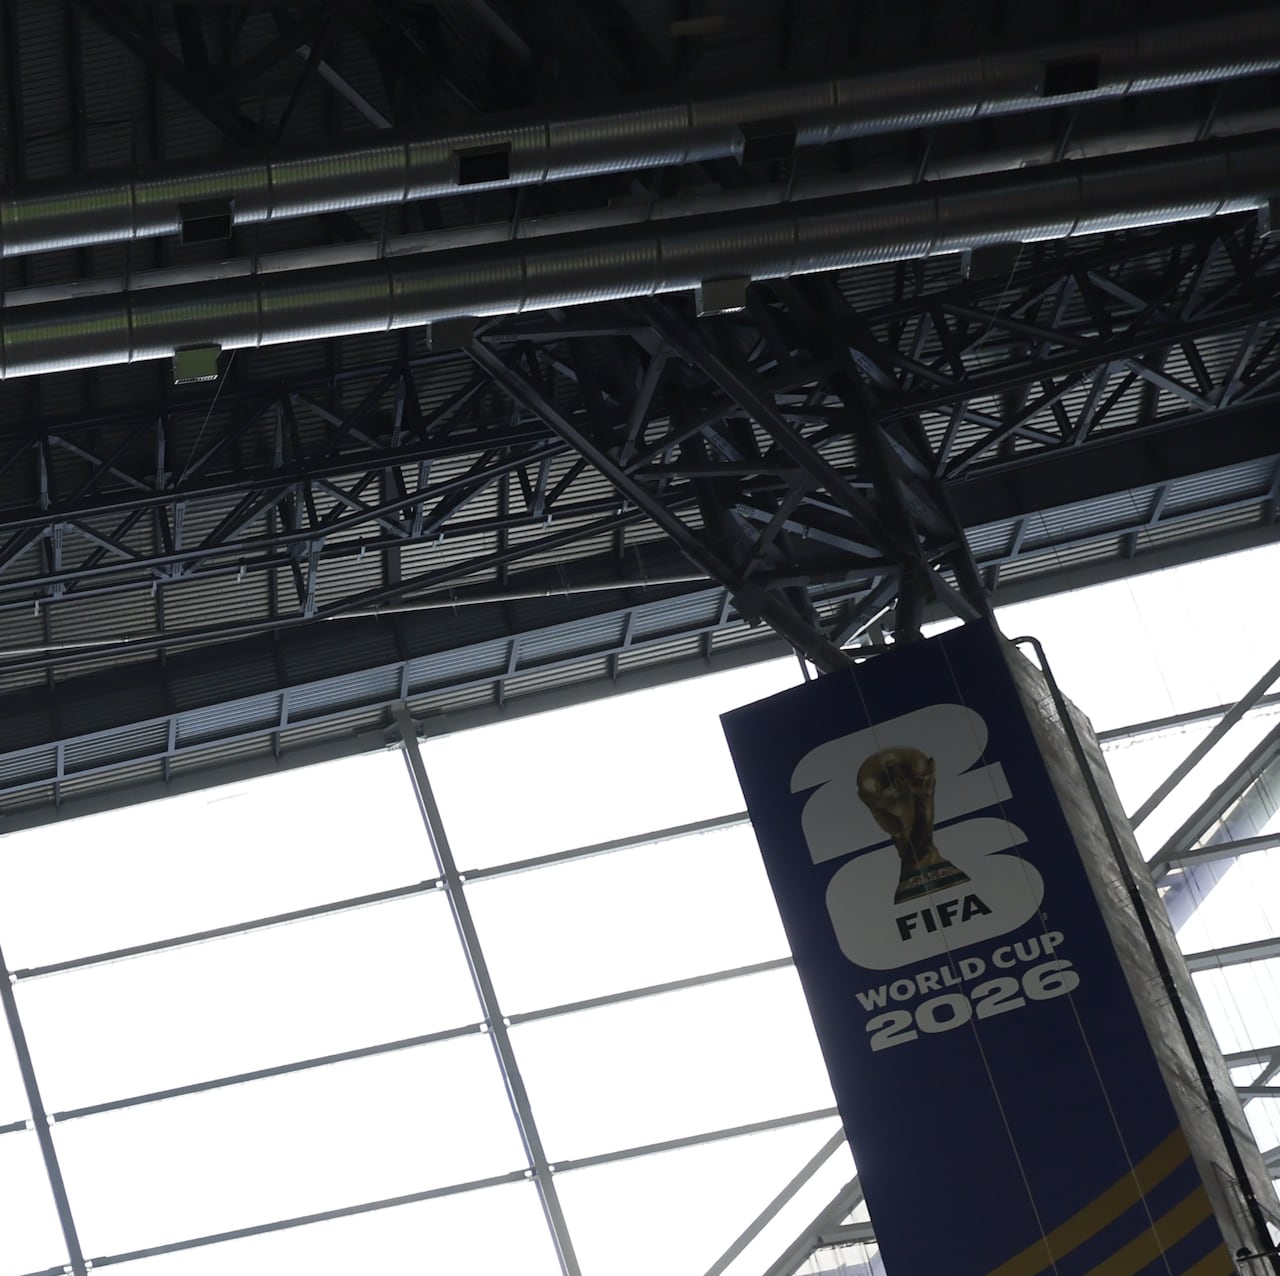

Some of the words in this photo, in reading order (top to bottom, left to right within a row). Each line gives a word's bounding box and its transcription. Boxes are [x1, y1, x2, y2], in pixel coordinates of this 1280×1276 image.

[895, 893, 992, 941] FIFA
[856, 955, 987, 1013] WORLD
[992, 930, 1065, 970] CUP
[865, 958, 1081, 1053] 2026
